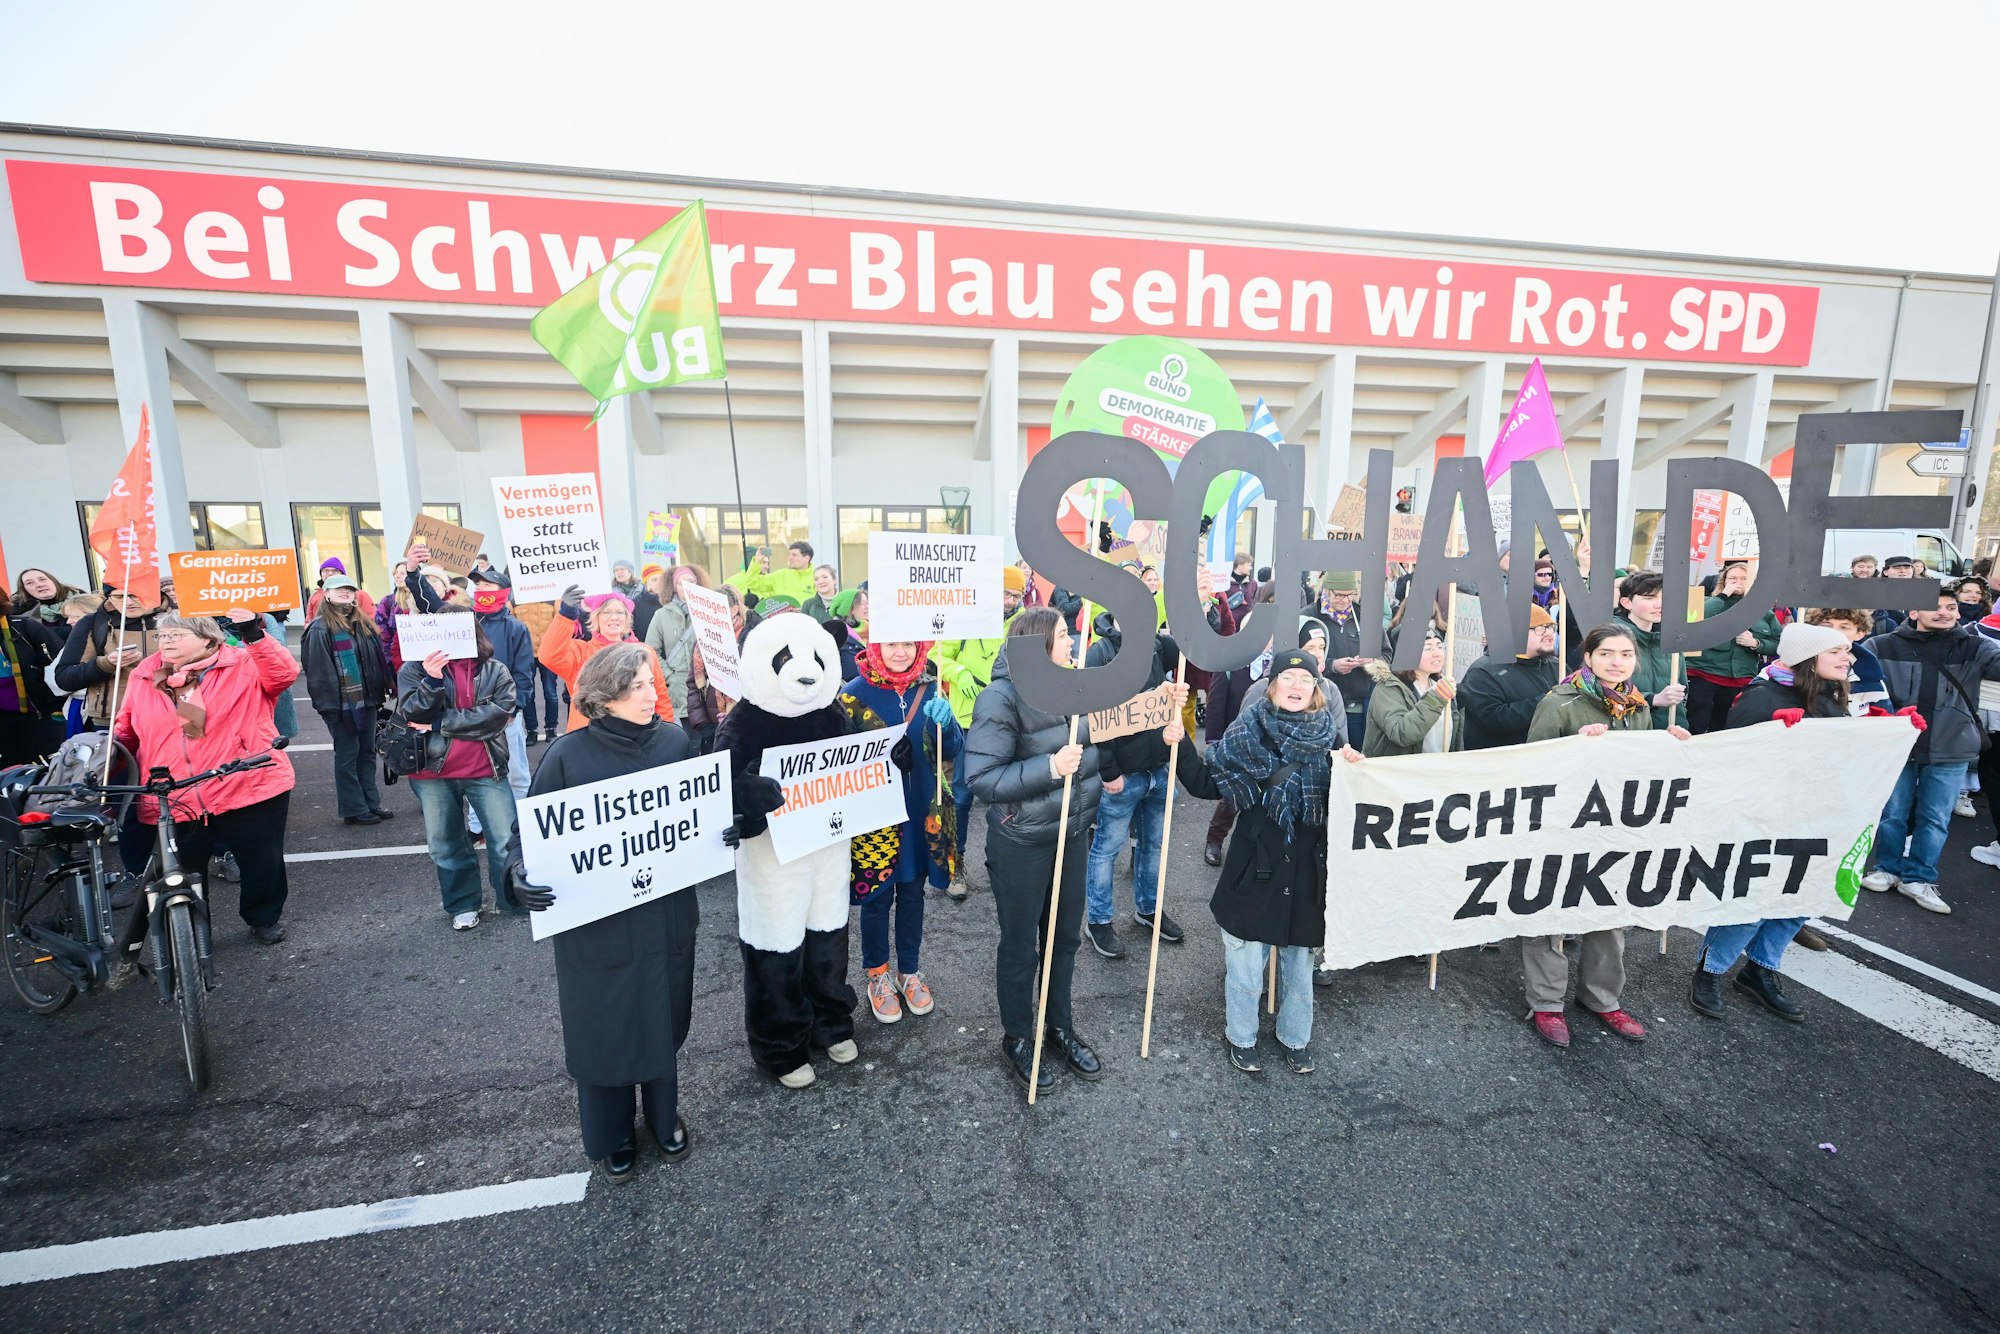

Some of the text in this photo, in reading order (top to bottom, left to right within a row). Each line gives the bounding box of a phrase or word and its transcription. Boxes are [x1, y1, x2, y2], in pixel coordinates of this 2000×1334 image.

[89, 180, 1787, 354] Bei Schwrz-Blau sehen wir Rot. SPD
[1147, 375, 1187, 397] BUND
[1107, 394, 1207, 432] DEMOKRATIE
[1933, 457, 1949, 471] ICC
[499, 483, 592, 501] Vermögen
[503, 502, 594, 519] besteuern
[415, 522, 478, 553] Wort halten
[533, 521, 574, 537] statt
[510, 538, 600, 559] Rechtsruck
[895, 542, 977, 562] KLIMASCHUTZ
[180, 553, 287, 568] Gemeinsam
[519, 555, 598, 575] befeuern!
[1008, 410, 1964, 715] SCHANDE
[209, 569, 266, 585] Nazis
[909, 566, 963, 584] BRAUCHT
[199, 585, 280, 603] stoppen
[685, 588, 728, 616] Vermögen
[897, 588, 977, 606] DEMOKRATIE!
[421, 619, 439, 627] viel
[689, 604, 731, 632] besteuern
[704, 627, 723, 644] statt
[698, 637, 739, 667] Rechtsruck
[705, 655, 740, 681] befeuern!
[1092, 694, 1168, 732] SHAME ON
[1144, 708, 1172, 729] YOU
[778, 738, 891, 780] WIR SIND DIE
[772, 759, 893, 817] RANDMAUER!
[533, 762, 721, 840] We listen and
[1351, 777, 1691, 850] RECHT AUF
[570, 808, 700, 875] we judge!
[1453, 838, 1828, 921] ZUKUNFT
[633, 887, 654, 899] WWF
